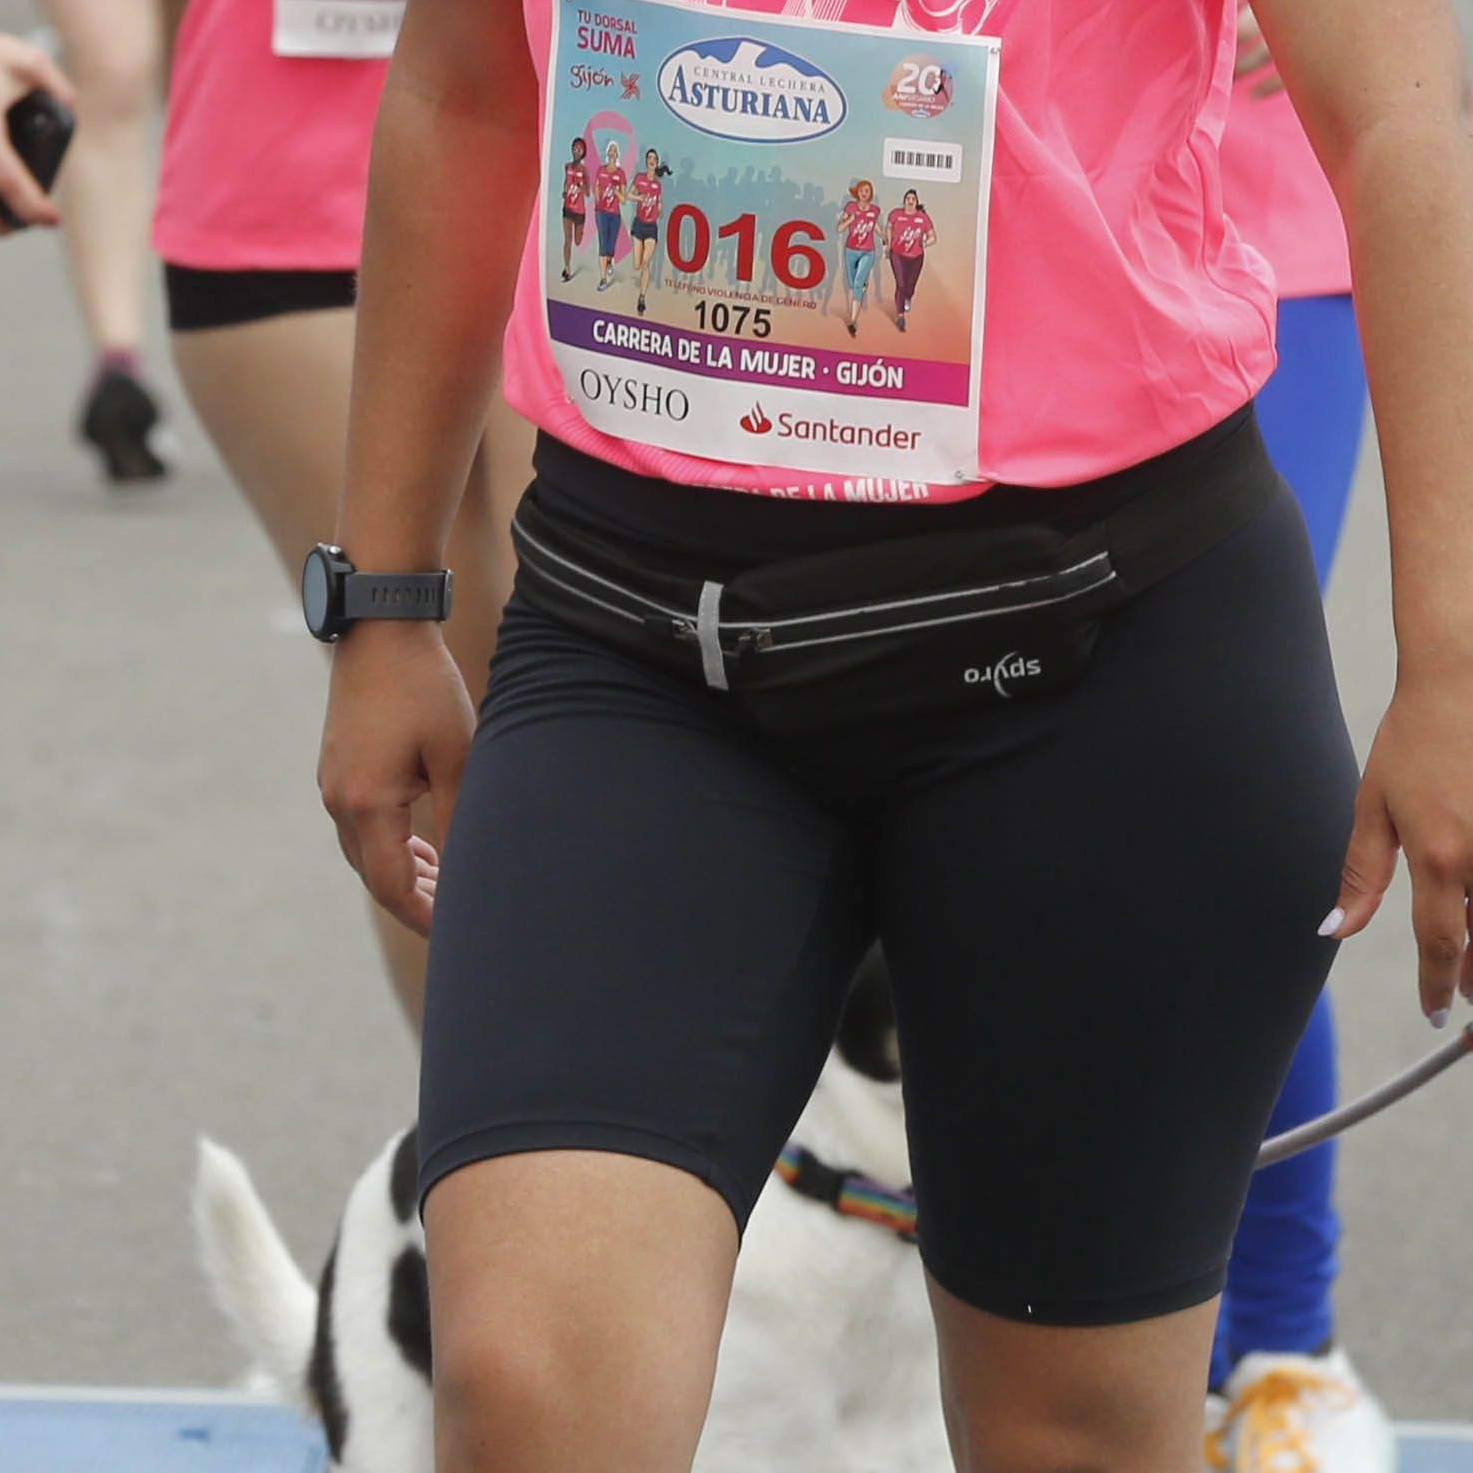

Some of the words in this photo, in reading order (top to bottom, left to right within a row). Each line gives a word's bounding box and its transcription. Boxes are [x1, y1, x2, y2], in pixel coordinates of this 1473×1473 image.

[577, 9, 591, 24] TU
[594, 13, 638, 35] DORSAL
[577, 26, 635, 60] SUMA
[668, 64, 831, 125] ASTURIANA
[693, 66, 753, 84] CENTRAL
[759, 76, 826, 93] LECHERA
[666, 203, 826, 290] 016
[695, 300, 771, 338] 1075
[593, 319, 672, 358] CARRERA
[678, 338, 701, 364] DE
[706, 344, 733, 369] LA
[740, 349, 816, 380] MUJER
[836, 358, 904, 389] GIJÓN
[580, 368, 690, 422] OYSHO
[778, 413, 921, 450] Santander
[964, 651, 1041, 697] spyro
